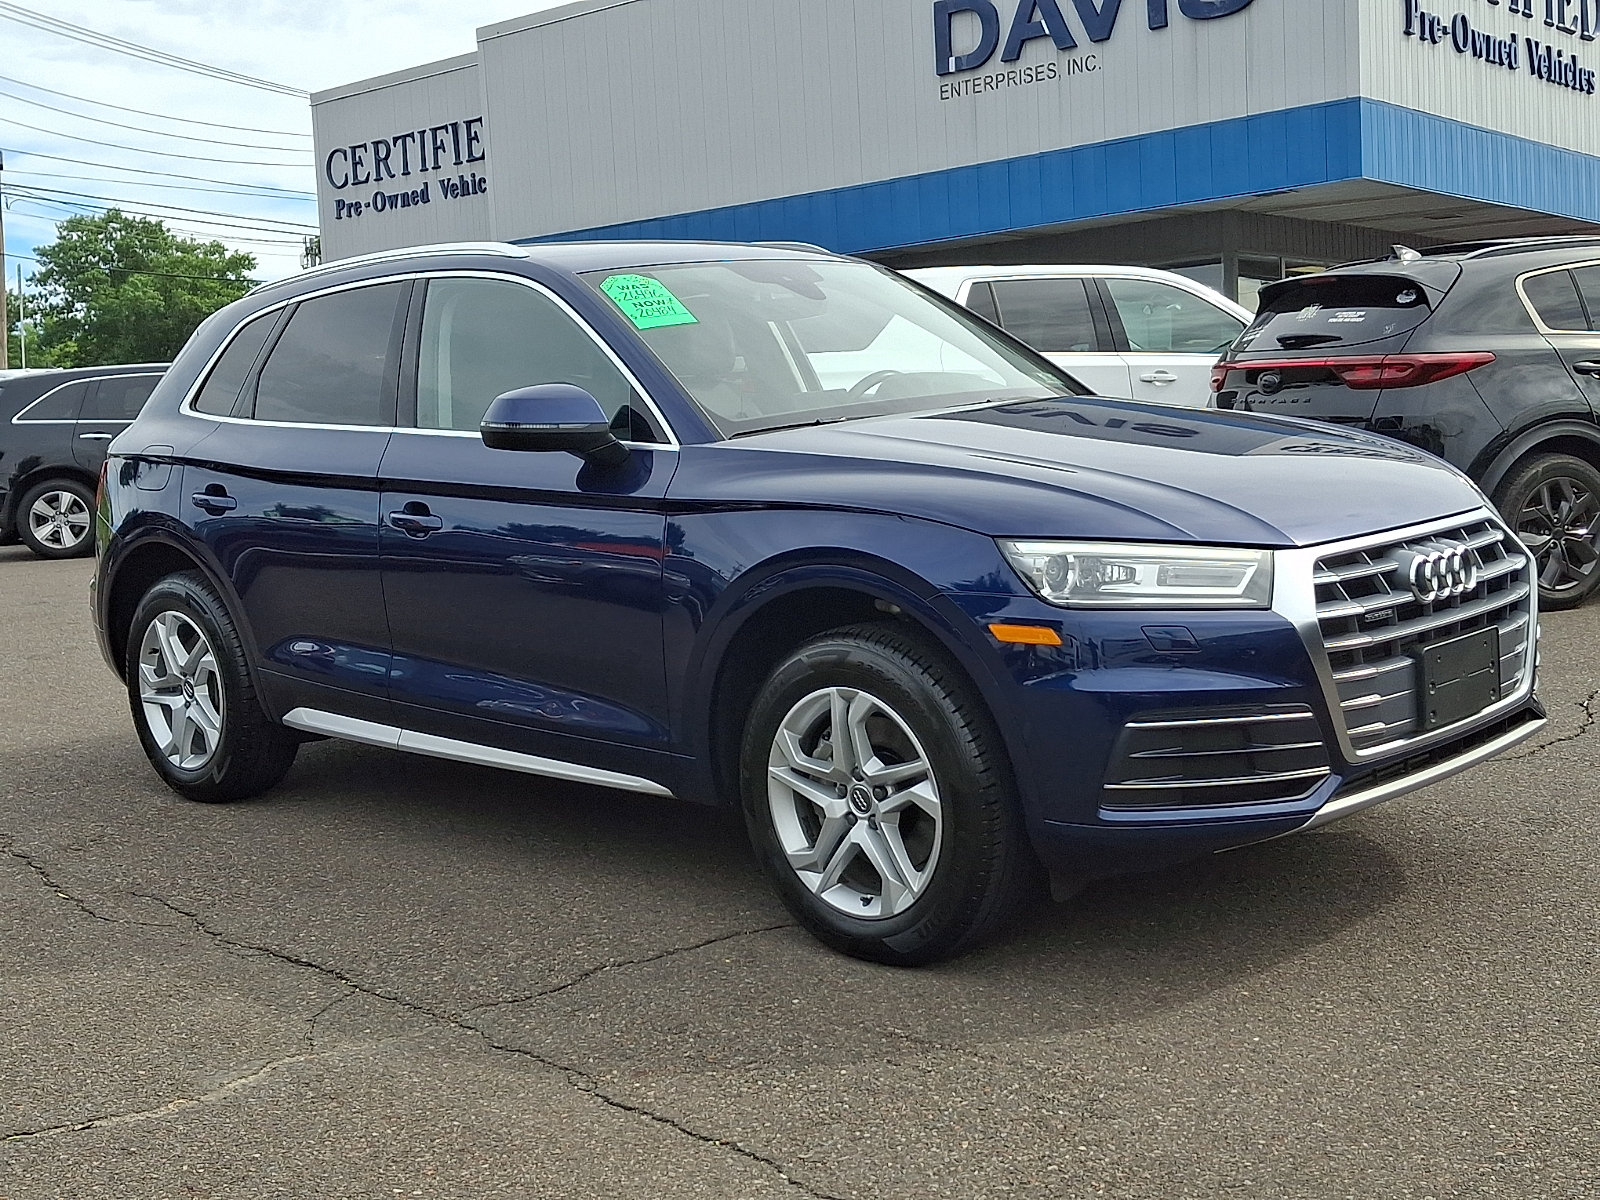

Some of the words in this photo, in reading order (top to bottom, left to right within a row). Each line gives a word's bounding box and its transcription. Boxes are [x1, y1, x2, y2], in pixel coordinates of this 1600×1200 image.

[933, 0, 1253, 76] DAV
[1403, 0, 1520, 70] Pre-Owned
[1525, 37, 1596, 95] Vehicles
[940, 62, 1062, 101] ENTERPRISES,
[1067, 54, 1102, 77] INC.
[325, 116, 486, 190] CERTIFIE
[334, 181, 431, 220] Pre-Owned
[438, 172, 488, 200] Vehic
[616, 283, 650, 291] WAS
